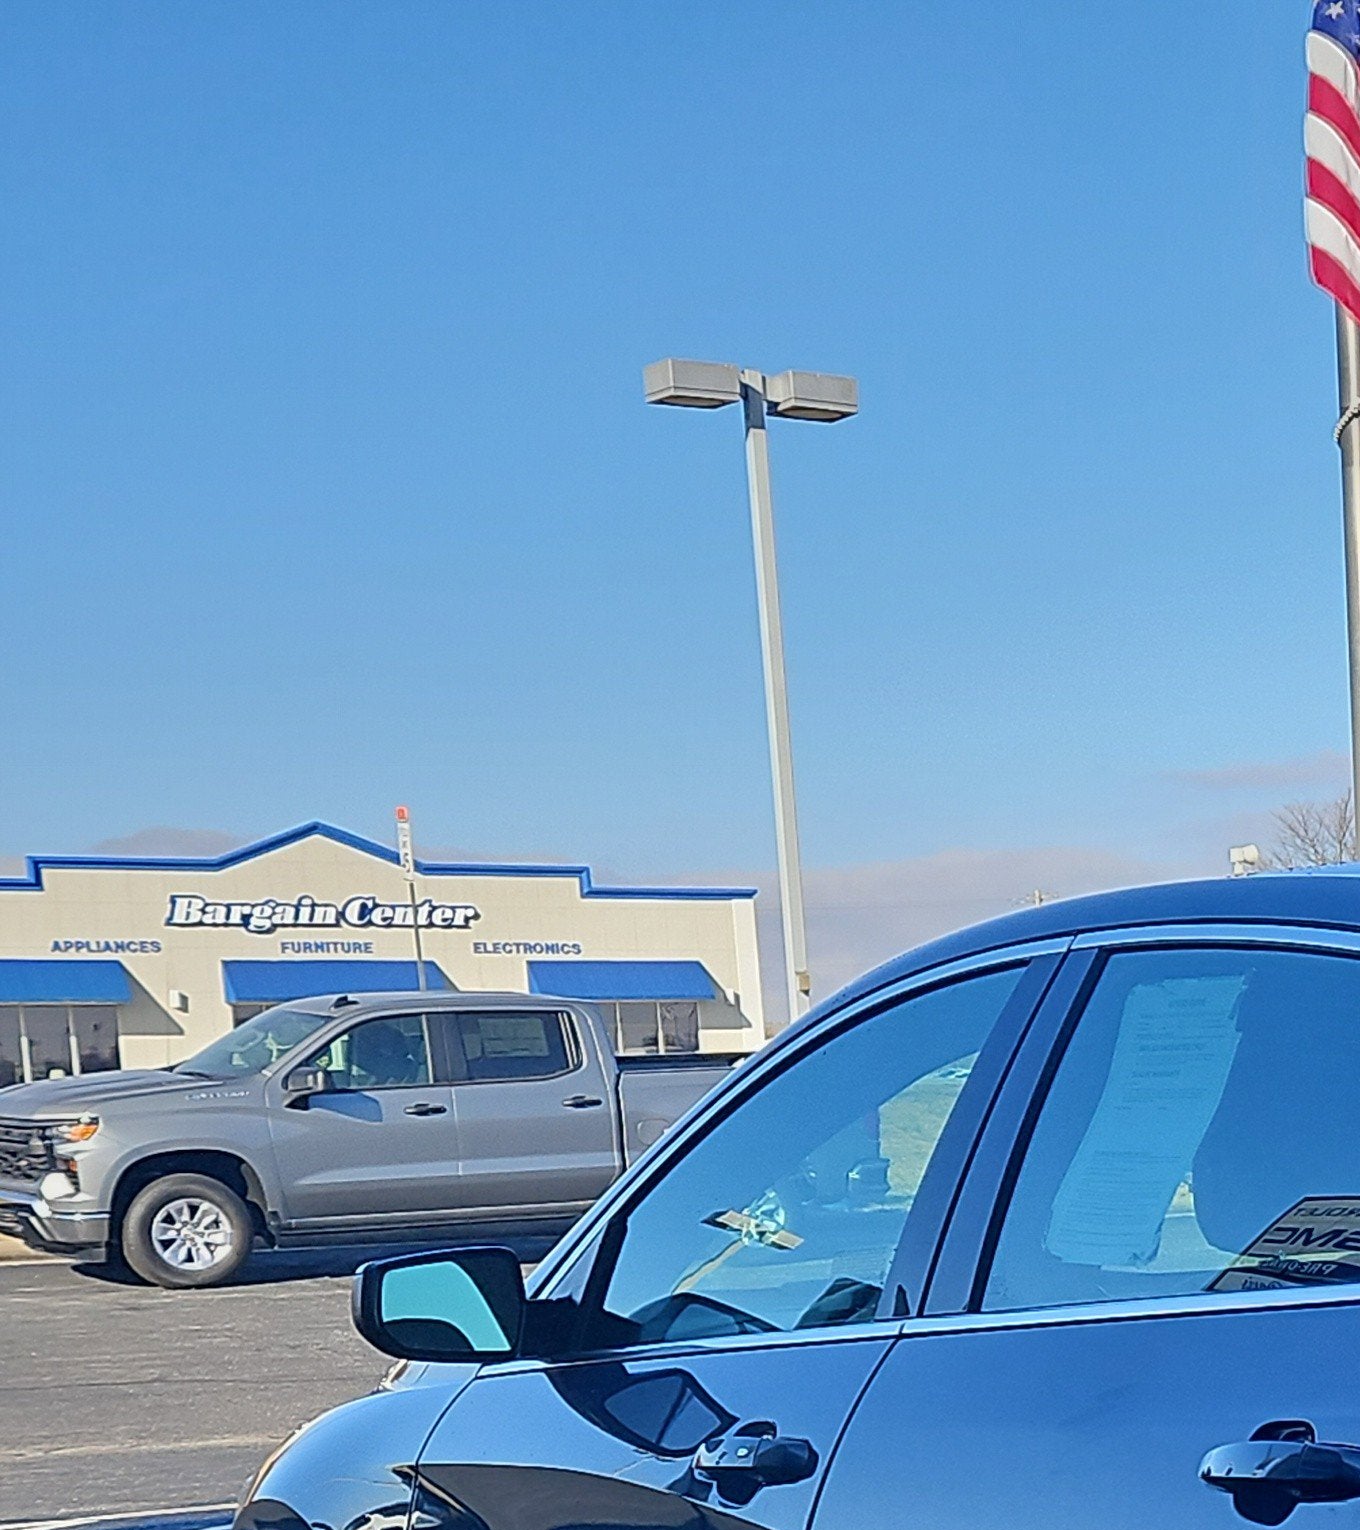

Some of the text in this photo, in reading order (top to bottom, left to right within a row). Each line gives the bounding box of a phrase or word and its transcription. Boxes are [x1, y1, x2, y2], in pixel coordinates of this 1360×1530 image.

[168, 896, 481, 933] Bargain Center
[50, 940, 162, 954] APPLIANCES
[280, 941, 374, 954] FURNITURE
[473, 942, 582, 955] ELECTRONICS
